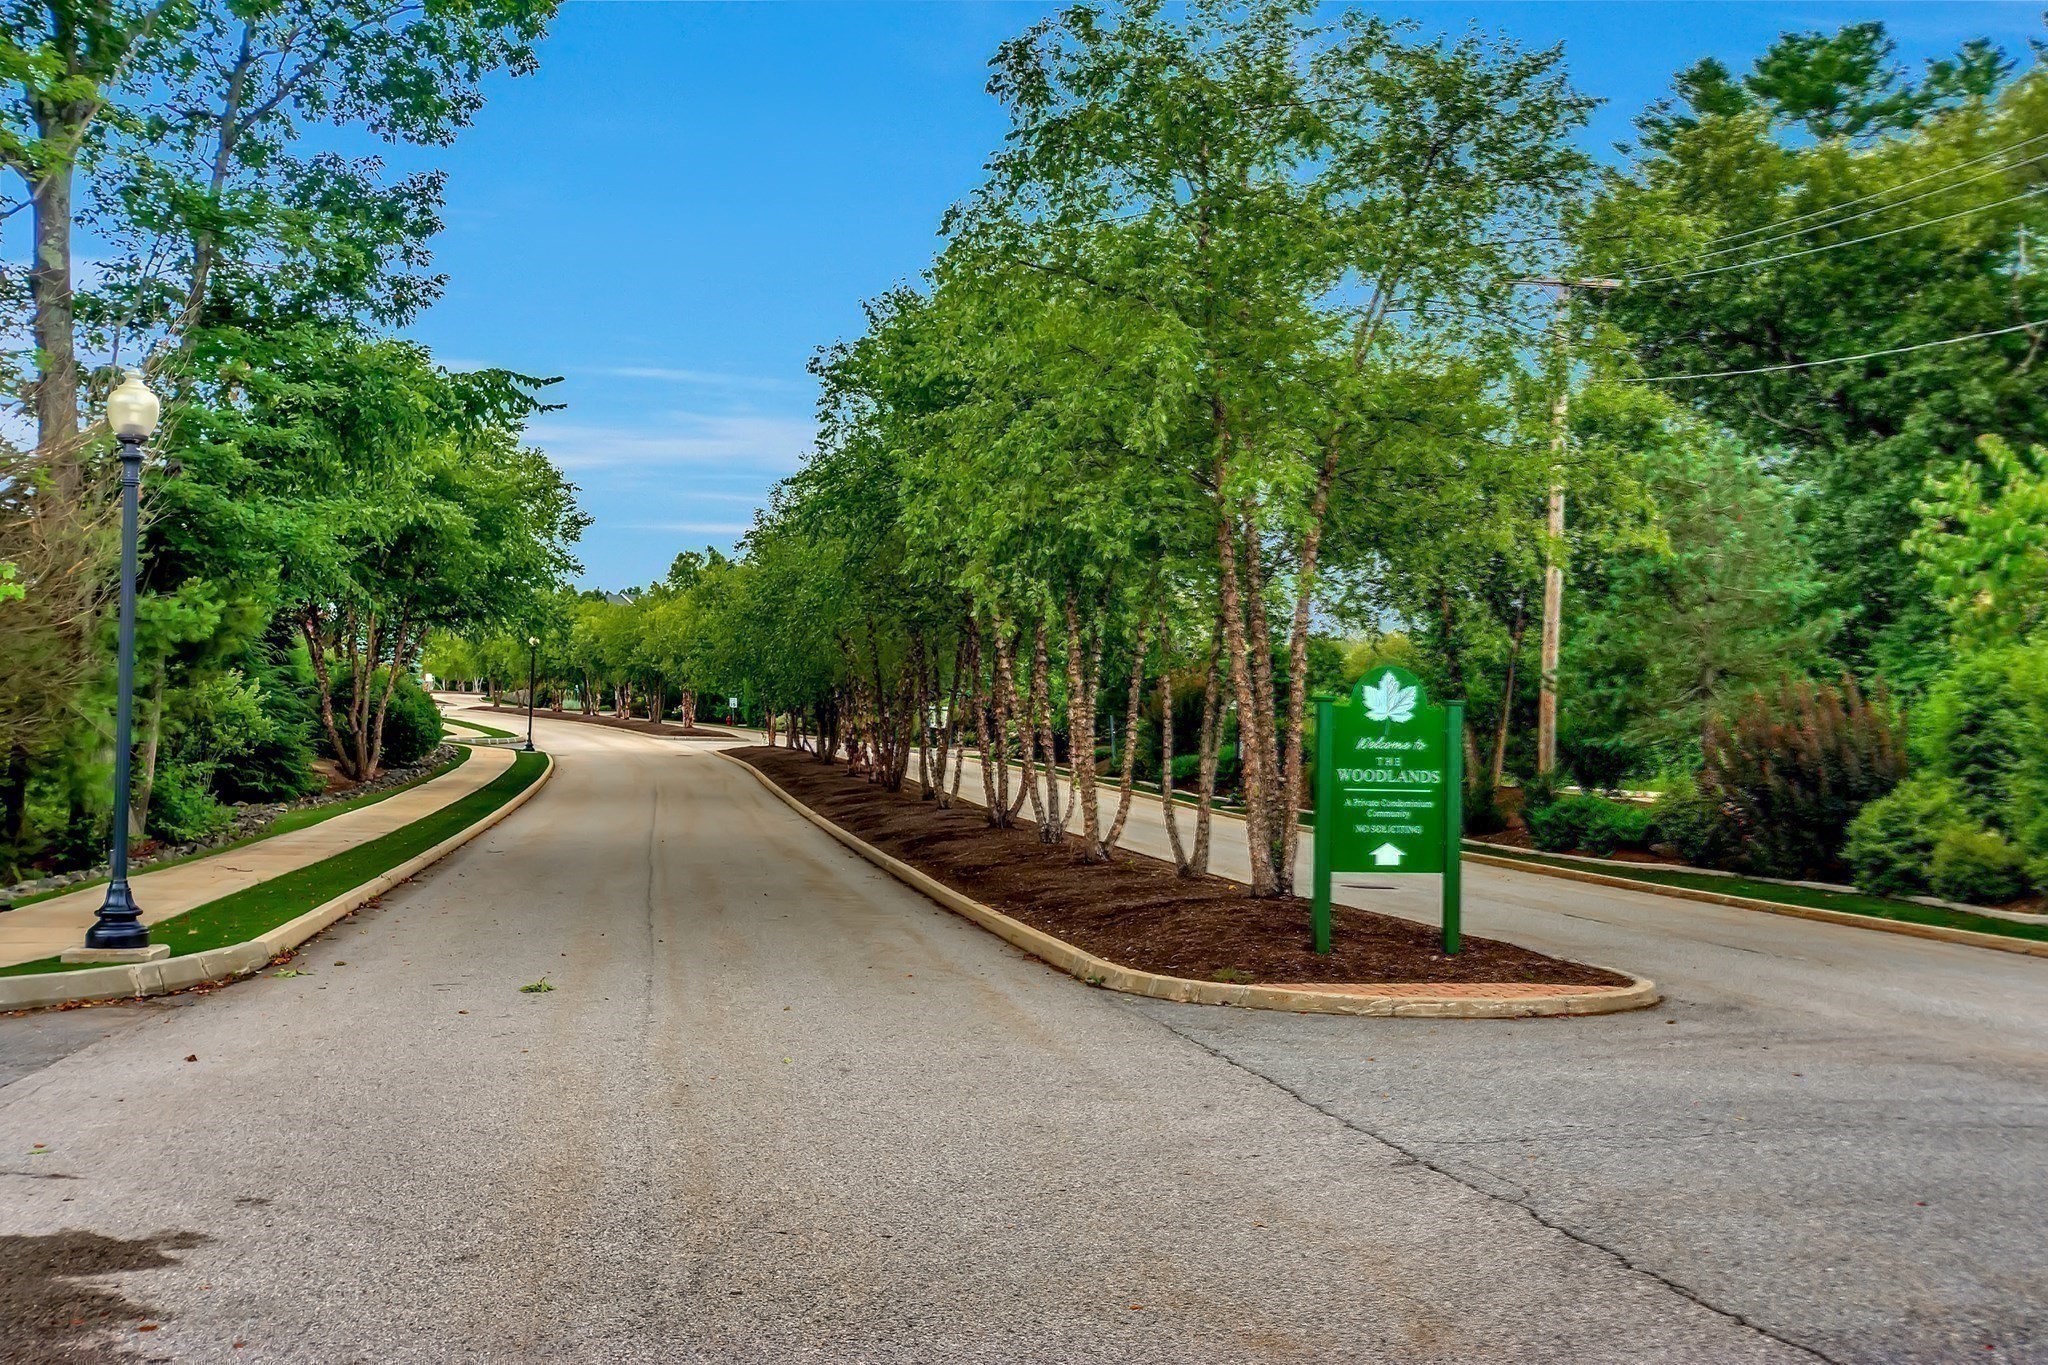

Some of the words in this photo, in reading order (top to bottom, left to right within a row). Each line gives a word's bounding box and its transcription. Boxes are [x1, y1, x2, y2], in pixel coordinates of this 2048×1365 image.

[1355, 736, 1411, 750] Welcome
[1412, 739, 1427, 750] to
[1375, 757, 1401, 766] THE
[1337, 769, 1441, 784] WOODLANDS
[1344, 799, 1352, 807] A
[1353, 799, 1379, 807] Private
[1380, 799, 1434, 808] Condominium
[1366, 809, 1411, 819] Community
[1355, 825, 1369, 833] NO
[1370, 825, 1423, 834] SOLICITING
